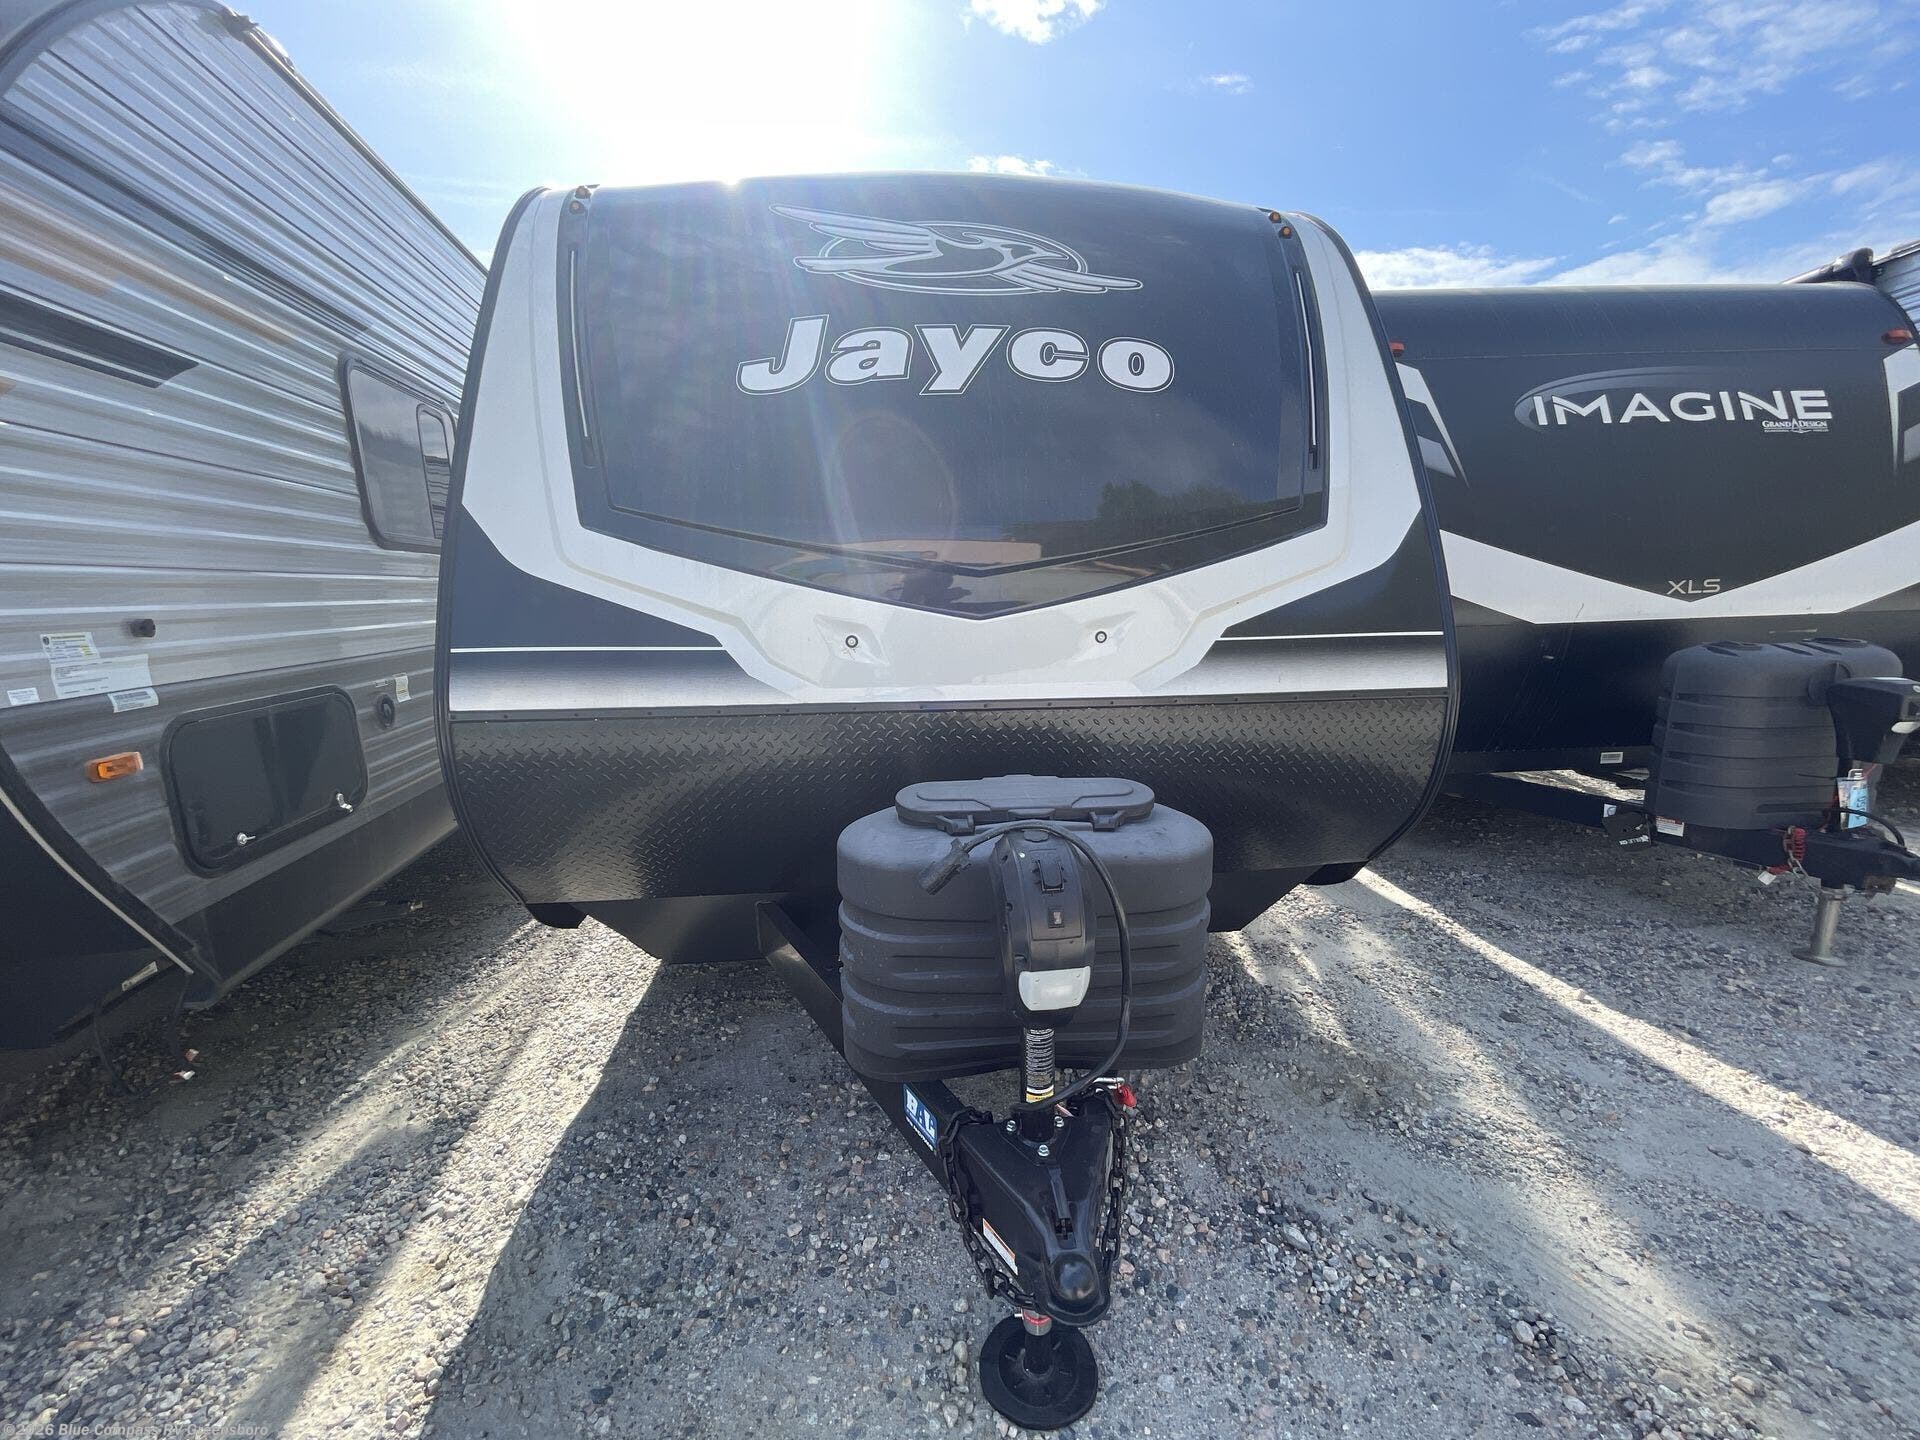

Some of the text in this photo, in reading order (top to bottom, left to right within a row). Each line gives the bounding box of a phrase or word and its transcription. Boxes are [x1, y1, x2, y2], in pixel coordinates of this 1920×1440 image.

[735, 314, 1175, 396] Jayco
[1533, 389, 1833, 426] IMAGINE
[1666, 578, 1721, 595] XLS
